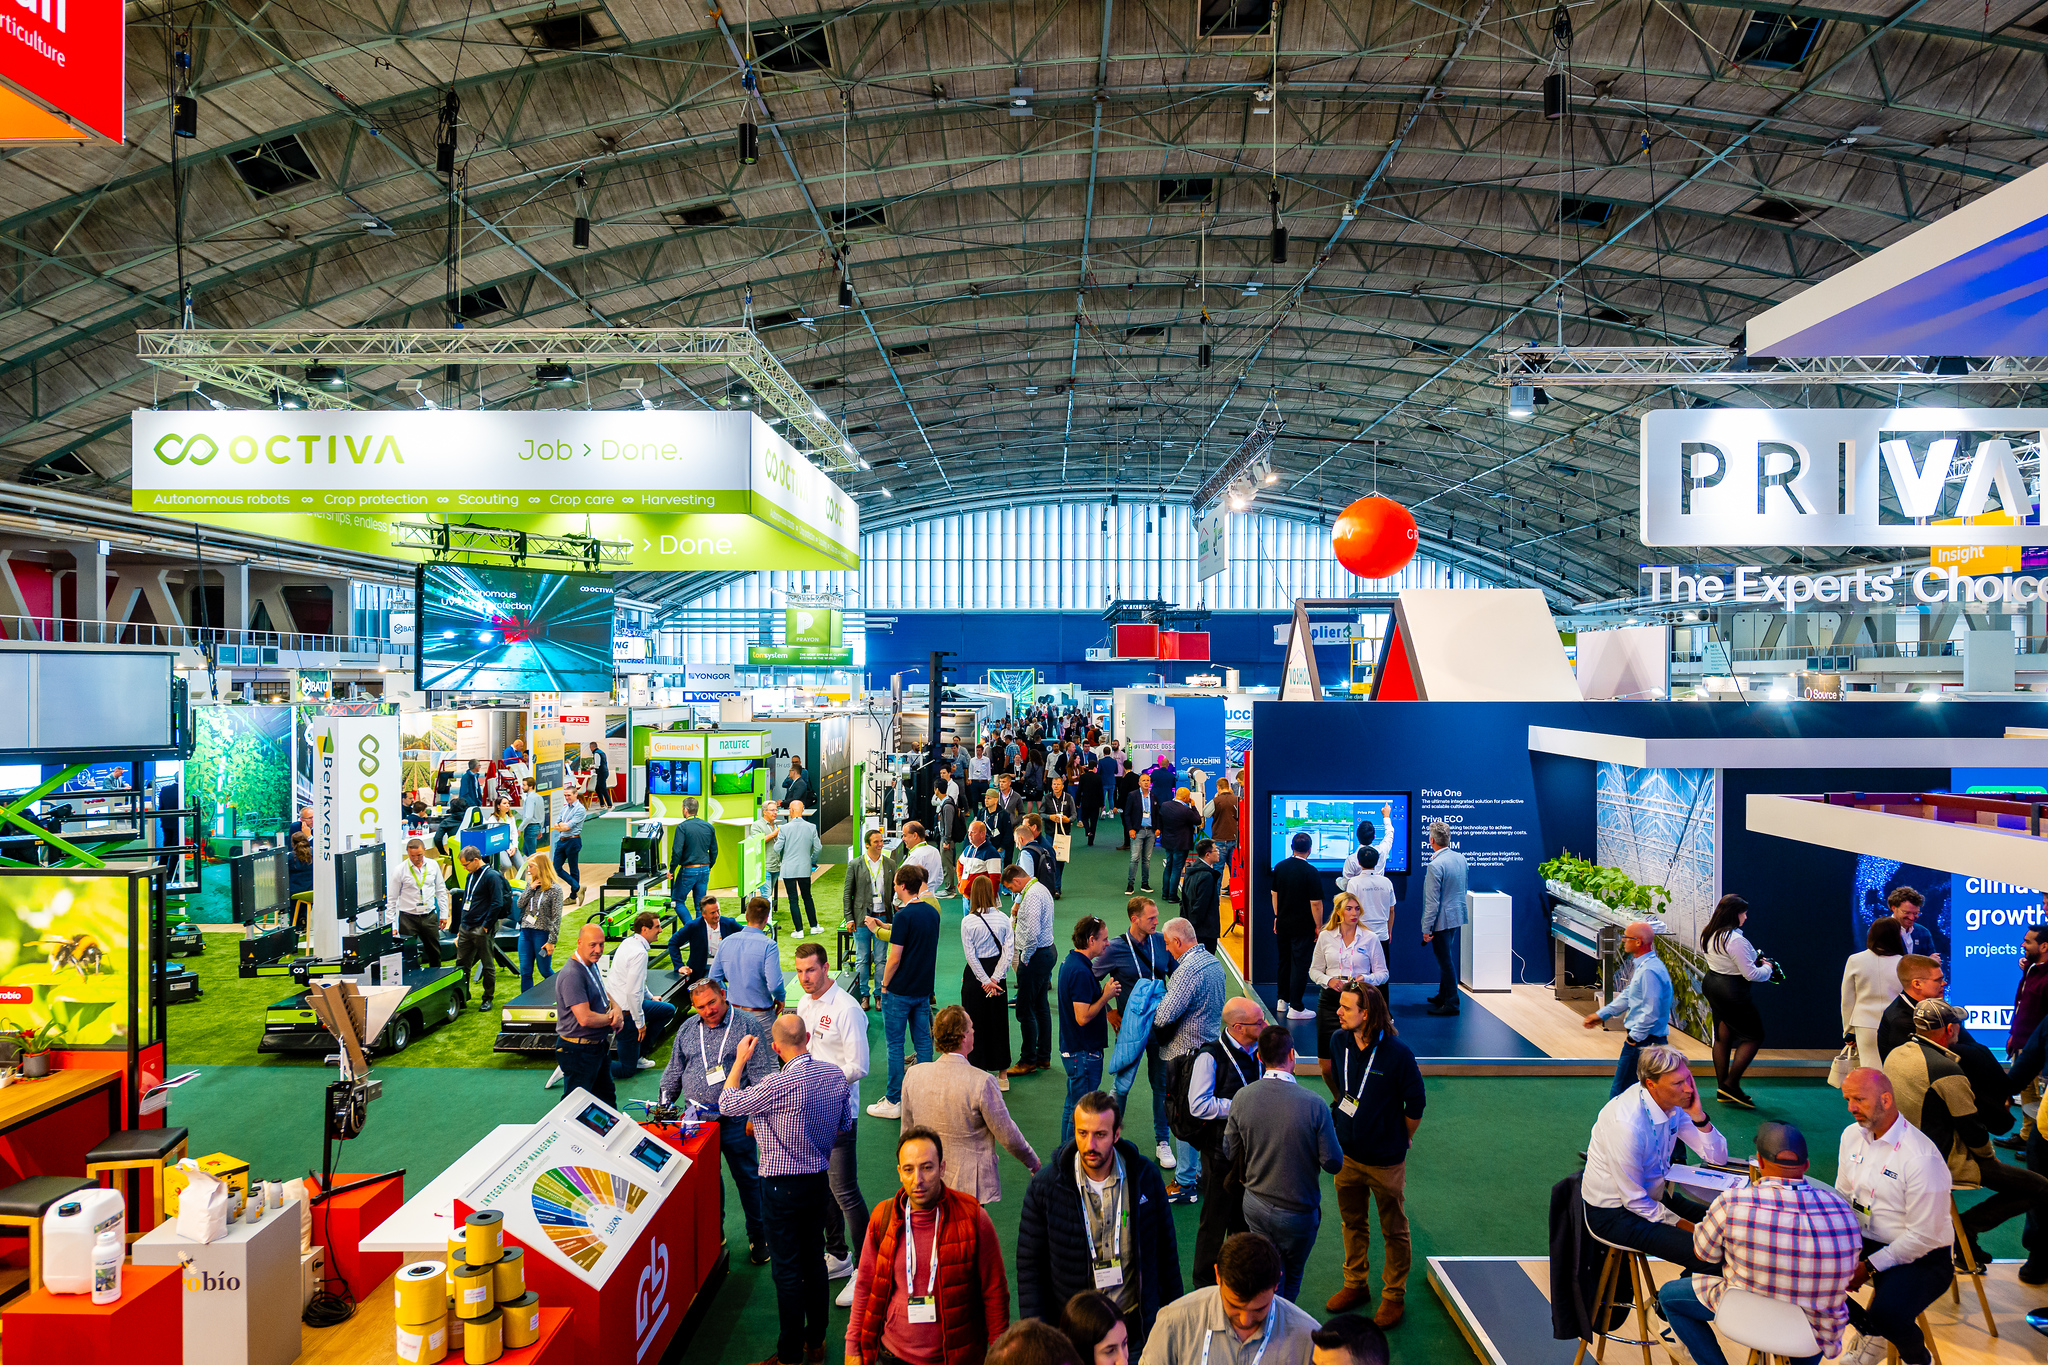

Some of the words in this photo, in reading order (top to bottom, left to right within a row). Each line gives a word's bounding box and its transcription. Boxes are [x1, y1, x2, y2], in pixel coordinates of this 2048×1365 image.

[0, 13, 66, 67] rticulture
[229, 434, 405, 465] OCTIVA
[518, 438, 573, 461] Job
[600, 438, 683, 461] Done.
[1680, 438, 2035, 517] PRIVA
[153, 493, 243, 506] Autonomous
[246, 493, 290, 506] robots
[323, 493, 355, 507] Crop
[358, 493, 428, 507] protection
[458, 493, 519, 508] Scouting
[549, 493, 582, 508] Crop
[584, 496, 615, 506] care
[641, 493, 716, 508] Harvesting
[354, 515, 388, 533] endless
[660, 534, 737, 555] Done.
[1938, 545, 1985, 563] Insight
[1641, 566, 1725, 603] The
[1311, 625, 1341, 640] plier
[613, 641, 629, 649] NG
[752, 651, 788, 660] tomsystem
[310, 681, 329, 692] BATO
[1813, 688, 1838, 700] Source
[1225, 709, 1253, 720] UCC
[654, 742, 694, 752] Continental
[1421, 788, 1442, 797] Priva
[1443, 788, 1462, 797] One
[323, 756, 333, 861] Berkvens
[359, 782, 379, 843] OCT
[1421, 815, 1442, 823] Priva
[1443, 815, 1463, 823] ECO
[1449, 841, 1460, 849] IM
[1965, 877, 2039, 894] clima
[1965, 943, 2018, 957] projects
[0, 991, 22, 1000] robío
[1969, 1010, 2014, 1025] PRIV
[480, 1173, 517, 1207] INTEGRATED
[513, 1160, 530, 1175] CROP
[527, 1131, 561, 1162] MANAGEMENT
[183, 1270, 241, 1292] obío
